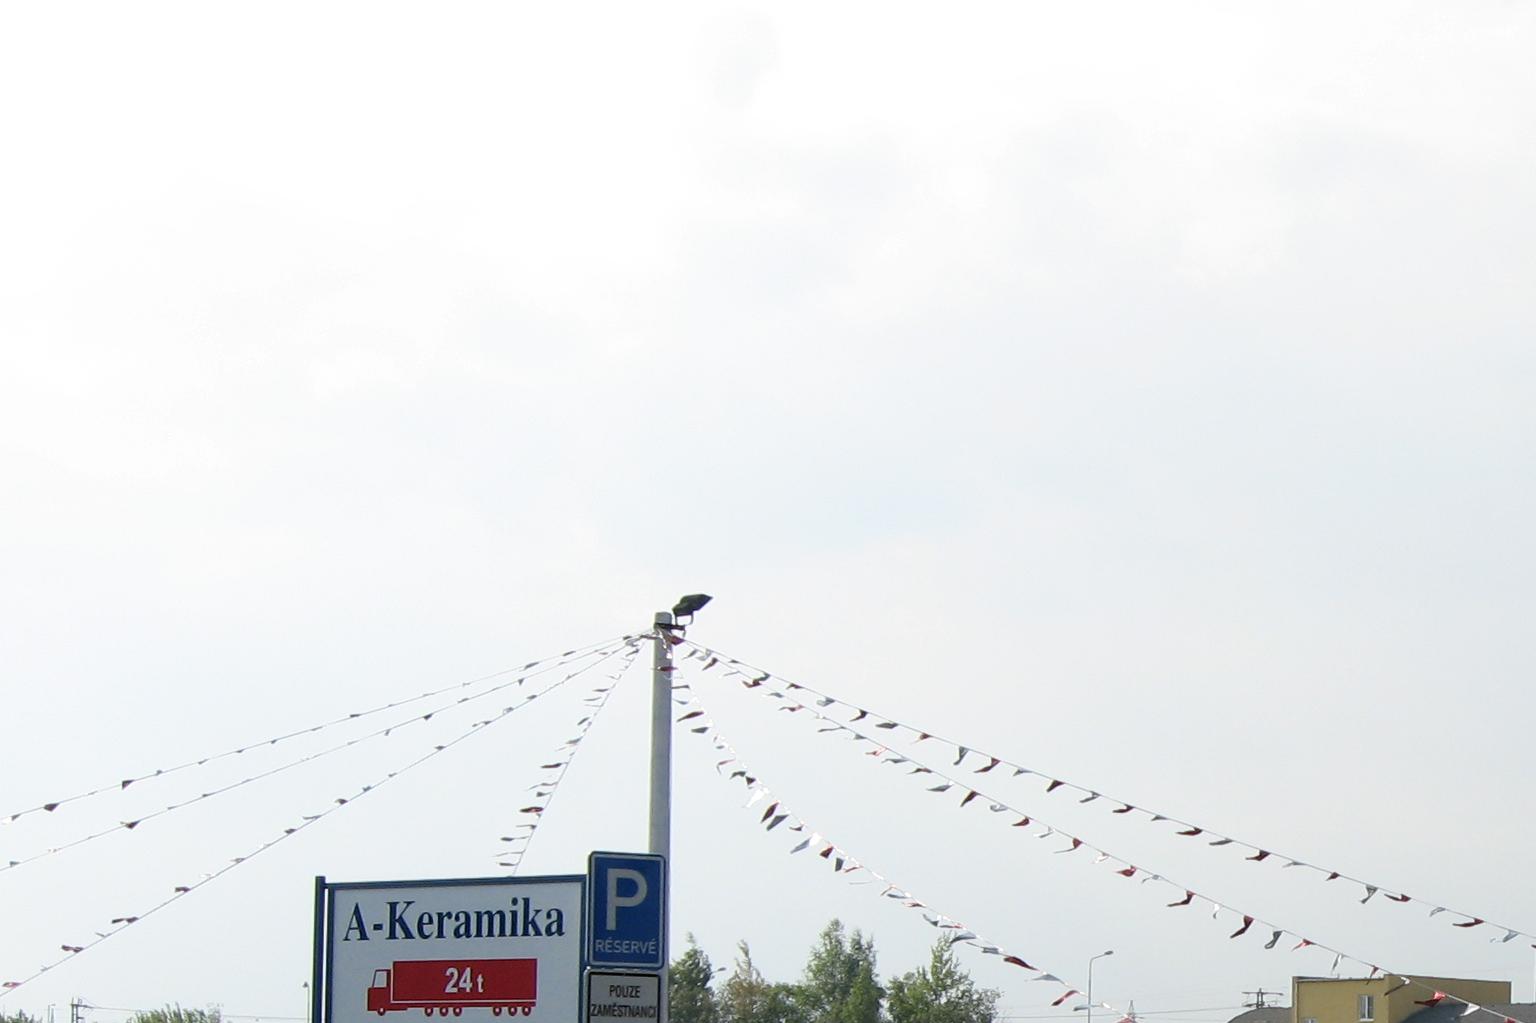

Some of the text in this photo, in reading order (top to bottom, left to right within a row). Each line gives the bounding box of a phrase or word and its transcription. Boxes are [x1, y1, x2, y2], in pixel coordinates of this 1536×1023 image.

[605, 867, 648, 931] P
[342, 897, 565, 942] A-Keramika
[594, 937, 657, 955] RÉSERVÉ
[444, 966, 484, 994] 24 t
[609, 984, 641, 998] POUZE
